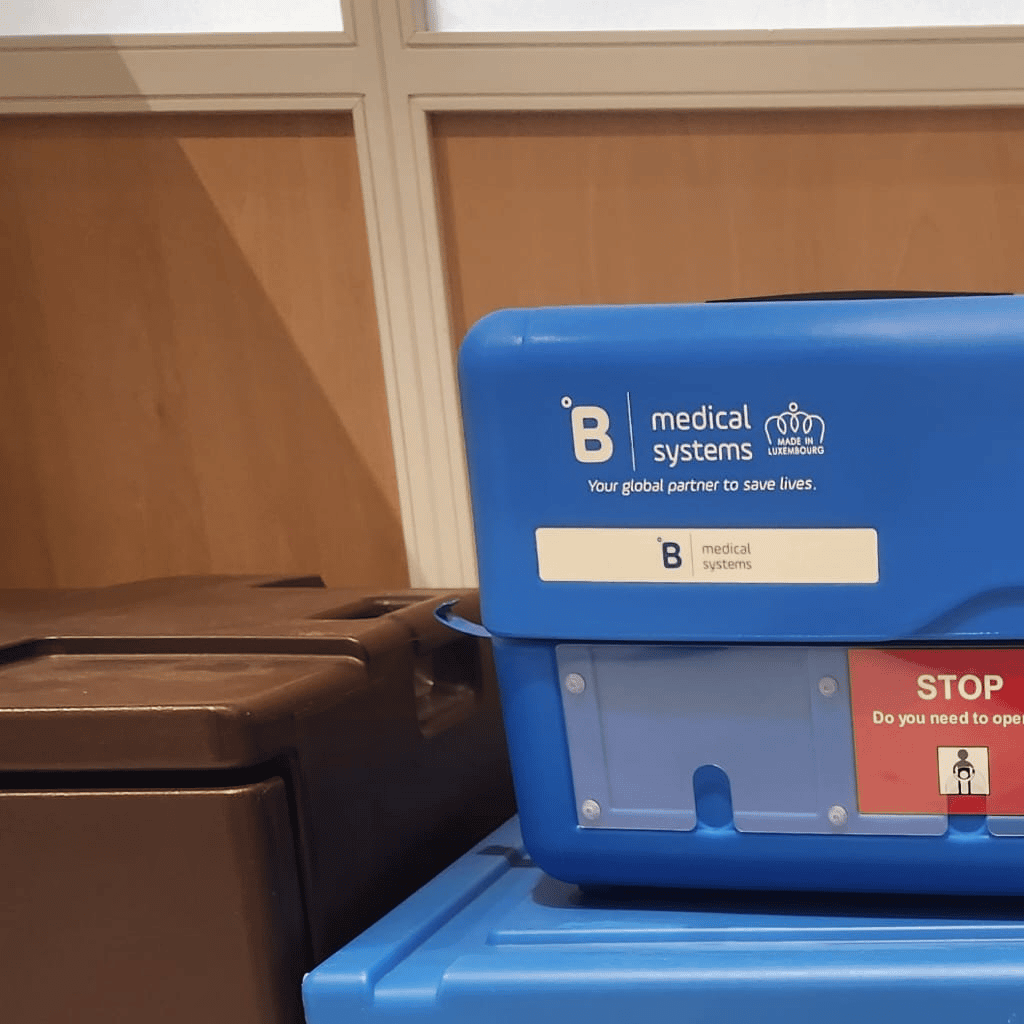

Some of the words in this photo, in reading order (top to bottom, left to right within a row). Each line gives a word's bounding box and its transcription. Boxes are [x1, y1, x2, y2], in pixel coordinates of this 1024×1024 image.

[651, 404, 752, 430] medical
[777, 437, 802, 446] MADE
[804, 437, 814, 446] IN
[653, 440, 753, 468] systems
[767, 446, 825, 456] LUXEMBOURG
[588, 479, 618, 493] Your
[622, 479, 664, 496] global
[668, 479, 719, 495] partner
[723, 479, 739, 491] to
[743, 480, 776, 492] save
[780, 476, 817, 491] lives.
[702, 542, 752, 555] medical
[703, 560, 753, 573] systems
[916, 674, 1004, 700] STOP
[873, 710, 895, 724] Do
[899, 712, 926, 727] you
[930, 711, 969, 724] need
[973, 711, 989, 724] to
